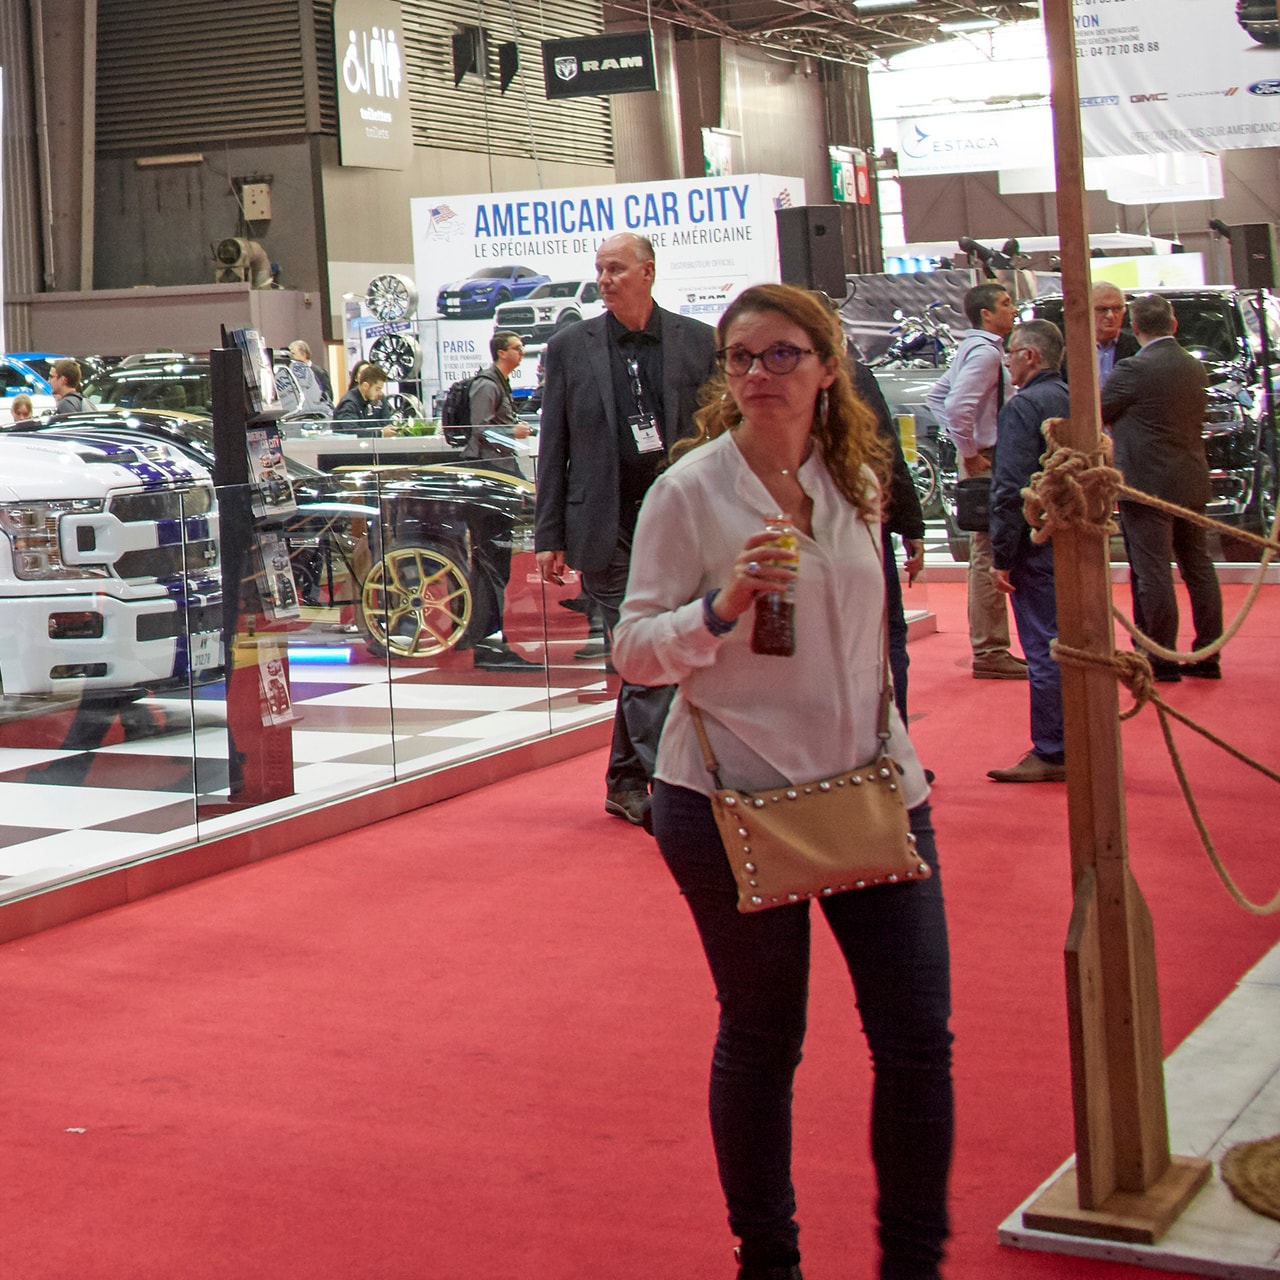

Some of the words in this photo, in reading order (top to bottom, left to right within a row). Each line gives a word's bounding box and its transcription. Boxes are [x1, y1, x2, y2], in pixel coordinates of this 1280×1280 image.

[1074, 14, 1100, 29] YON
[1076, 47, 1088, 58] EL:
[1091, 47, 1102, 57] 04
[1105, 45, 1116, 56] 72
[1119, 44, 1130, 55] 70
[582, 56, 643, 72] RAM
[1130, 92, 1168, 104] GMC
[1228, 122, 1280, 135] AMERICANC
[933, 137, 1000, 153] ESTACA
[474, 196, 614, 238] AMERICAN
[624, 191, 679, 229] CAR
[688, 184, 750, 223] CITY
[474, 243, 489, 258] LE
[492, 237, 570, 258] SPÉCIALISTE
[573, 238, 589, 254] DE
[672, 225, 753, 247] AMÉRICAINE
[443, 340, 475, 354] PARIS
